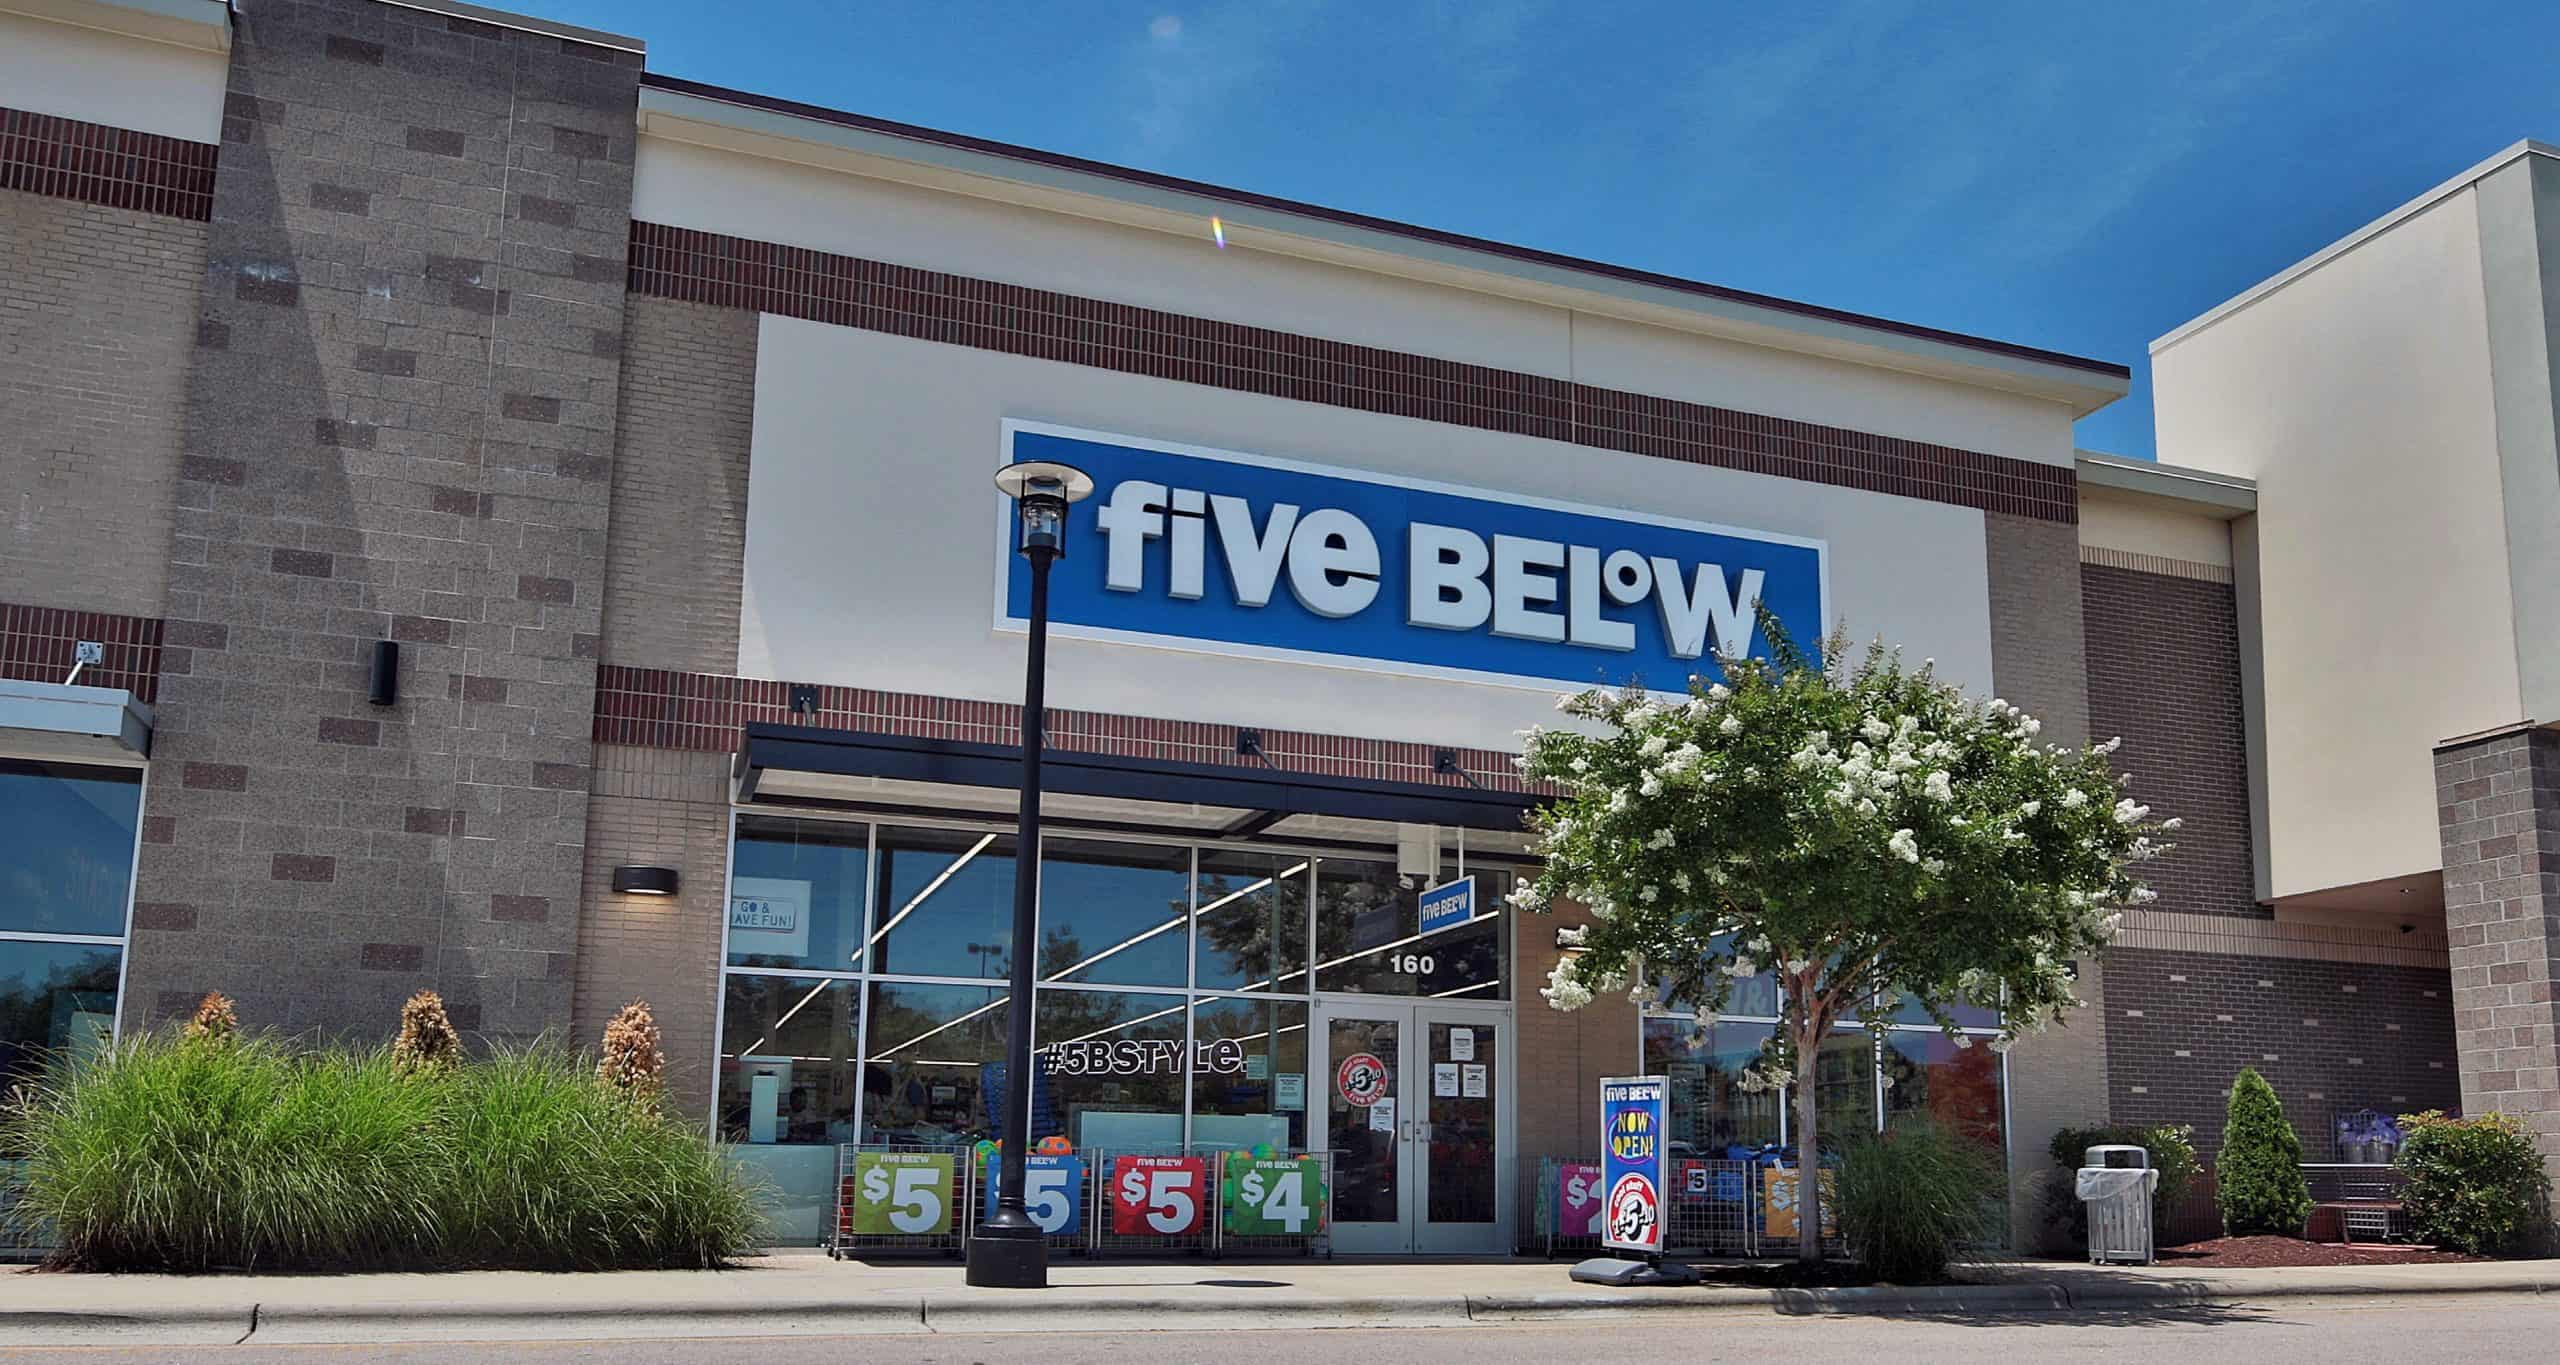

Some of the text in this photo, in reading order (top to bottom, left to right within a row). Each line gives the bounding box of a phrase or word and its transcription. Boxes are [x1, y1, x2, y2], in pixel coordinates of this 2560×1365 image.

[1096, 480, 1381, 618] five
[733, 913, 758, 926] AVE
[1423, 902, 1440, 922] five
[1390, 954, 1435, 975] 160
[1617, 1111, 1649, 1133] NOW
[1613, 1135, 1654, 1157] OPEN!
[1689, 1172, 1705, 1188] $5
[861, 1164, 942, 1233] $5
[994, 1166, 1070, 1233] 5
[1121, 1168, 1195, 1233] $5
[1241, 1169, 1310, 1233] $4
